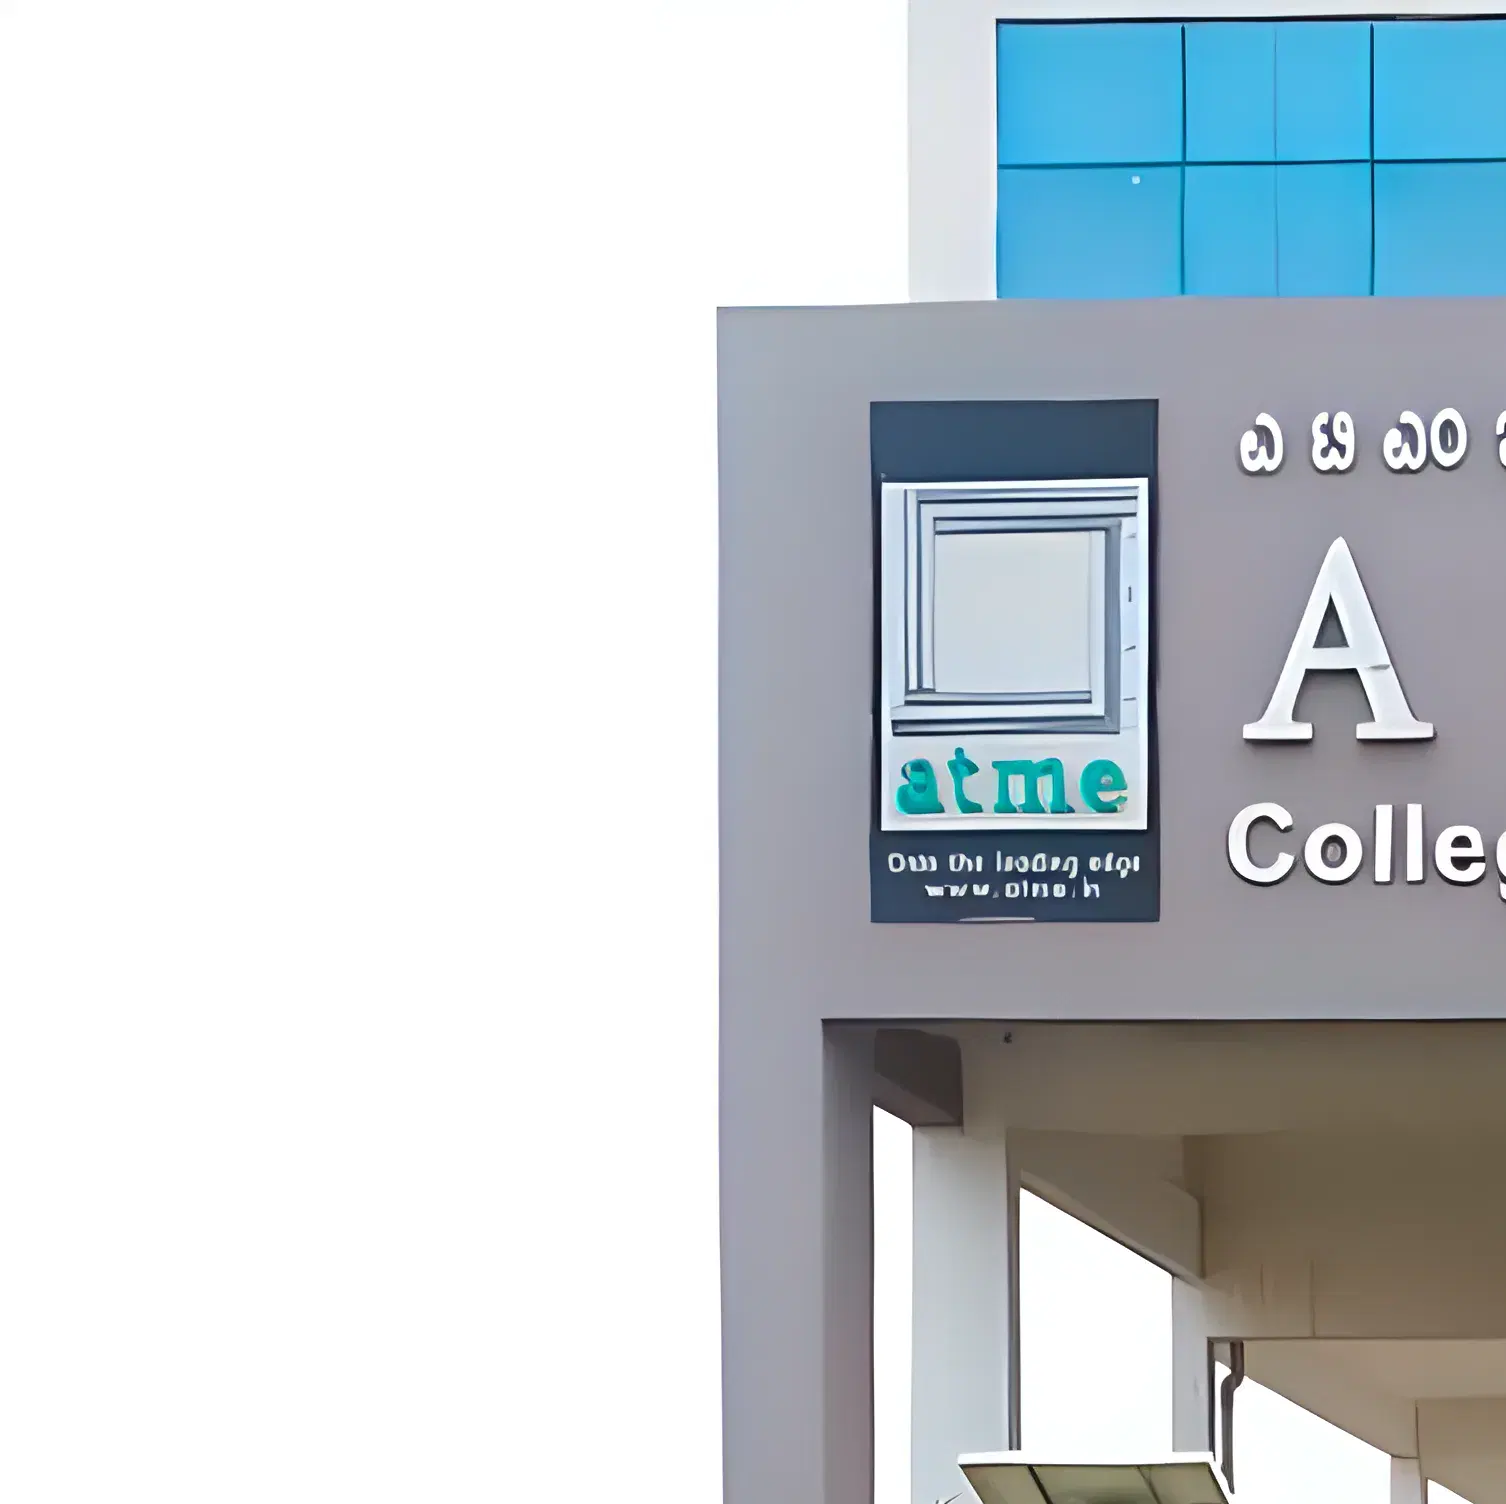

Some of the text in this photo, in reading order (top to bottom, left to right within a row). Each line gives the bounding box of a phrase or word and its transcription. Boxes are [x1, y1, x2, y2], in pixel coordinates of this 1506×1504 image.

[1239, 411, 1284, 473] ಎ
[1383, 406, 1468, 471] ಎಂ
[894, 746, 1129, 815] atme
